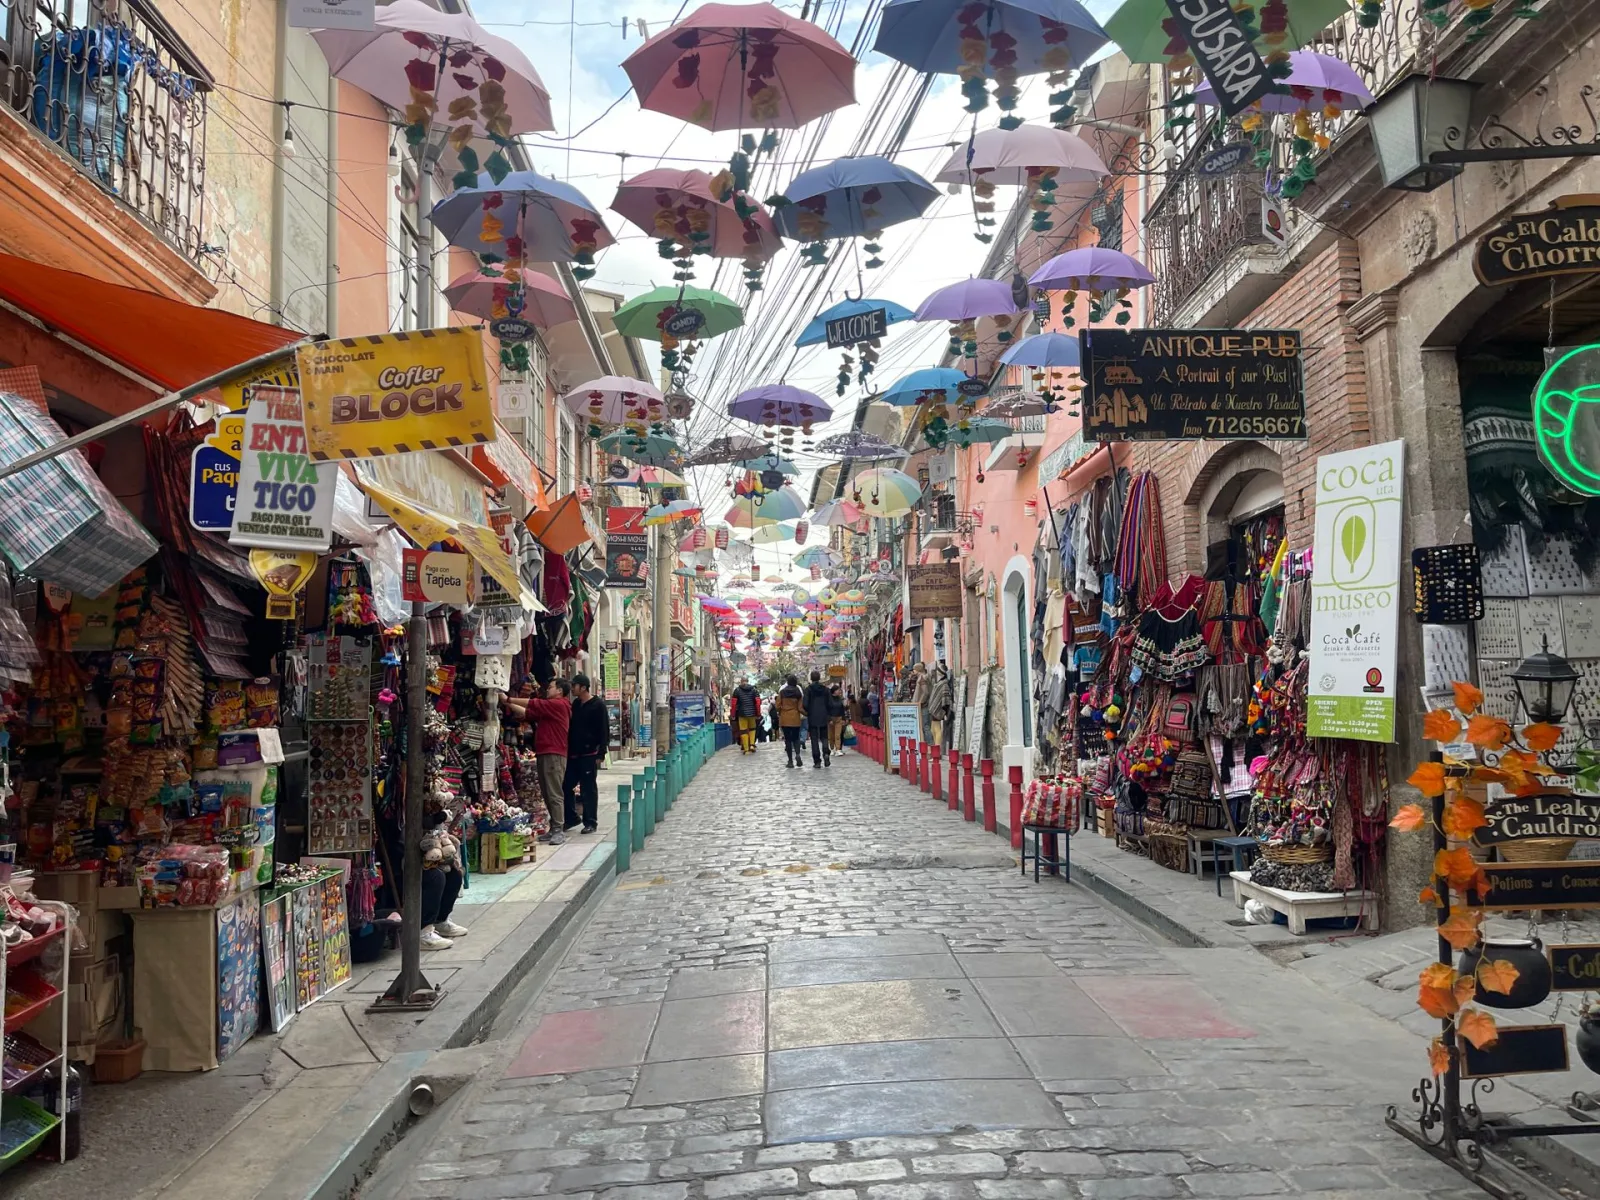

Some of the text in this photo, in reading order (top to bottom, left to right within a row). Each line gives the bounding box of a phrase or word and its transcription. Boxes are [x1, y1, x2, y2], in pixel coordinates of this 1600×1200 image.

[1175, 0, 1263, 104] SUSARA
[1205, 148, 1241, 172] CANDY
[1517, 221, 1537, 236] El
[1502, 243, 1600, 272] Chorr
[498, 323, 528, 335] CANDY
[671, 316, 696, 331] CANDY
[828, 311, 881, 344] WELCOME
[313, 351, 375, 365] CHOCOLATE
[314, 364, 345, 376] MANI
[378, 364, 445, 391] Cofler
[1155, 363, 1287, 390] A Portrait of our Past
[331, 383, 464, 425] BLOCK
[1150, 392, 1299, 412] Un Retrato de Nuestro Pasado
[1205, 416, 1303, 435] 71265667
[214, 462, 232, 472] tus
[256, 452, 319, 485] VIVA
[1321, 456, 1397, 492] coca
[202, 467, 241, 489] Paq
[253, 480, 317, 512] TIGO
[250, 511, 313, 527] PAGO POR QR Y
[237, 521, 325, 538] VENTAS CON TARJETA
[607, 535, 627, 543] MOSHI
[425, 564, 438, 574] Paga
[425, 573, 462, 588] Tarjeta
[1316, 590, 1392, 612] museo
[1323, 632, 1381, 645] Coca Café
[1502, 798, 1600, 822] The Leaky
[1502, 816, 1600, 838] Cauldro
[1490, 874, 1533, 893] Potions
